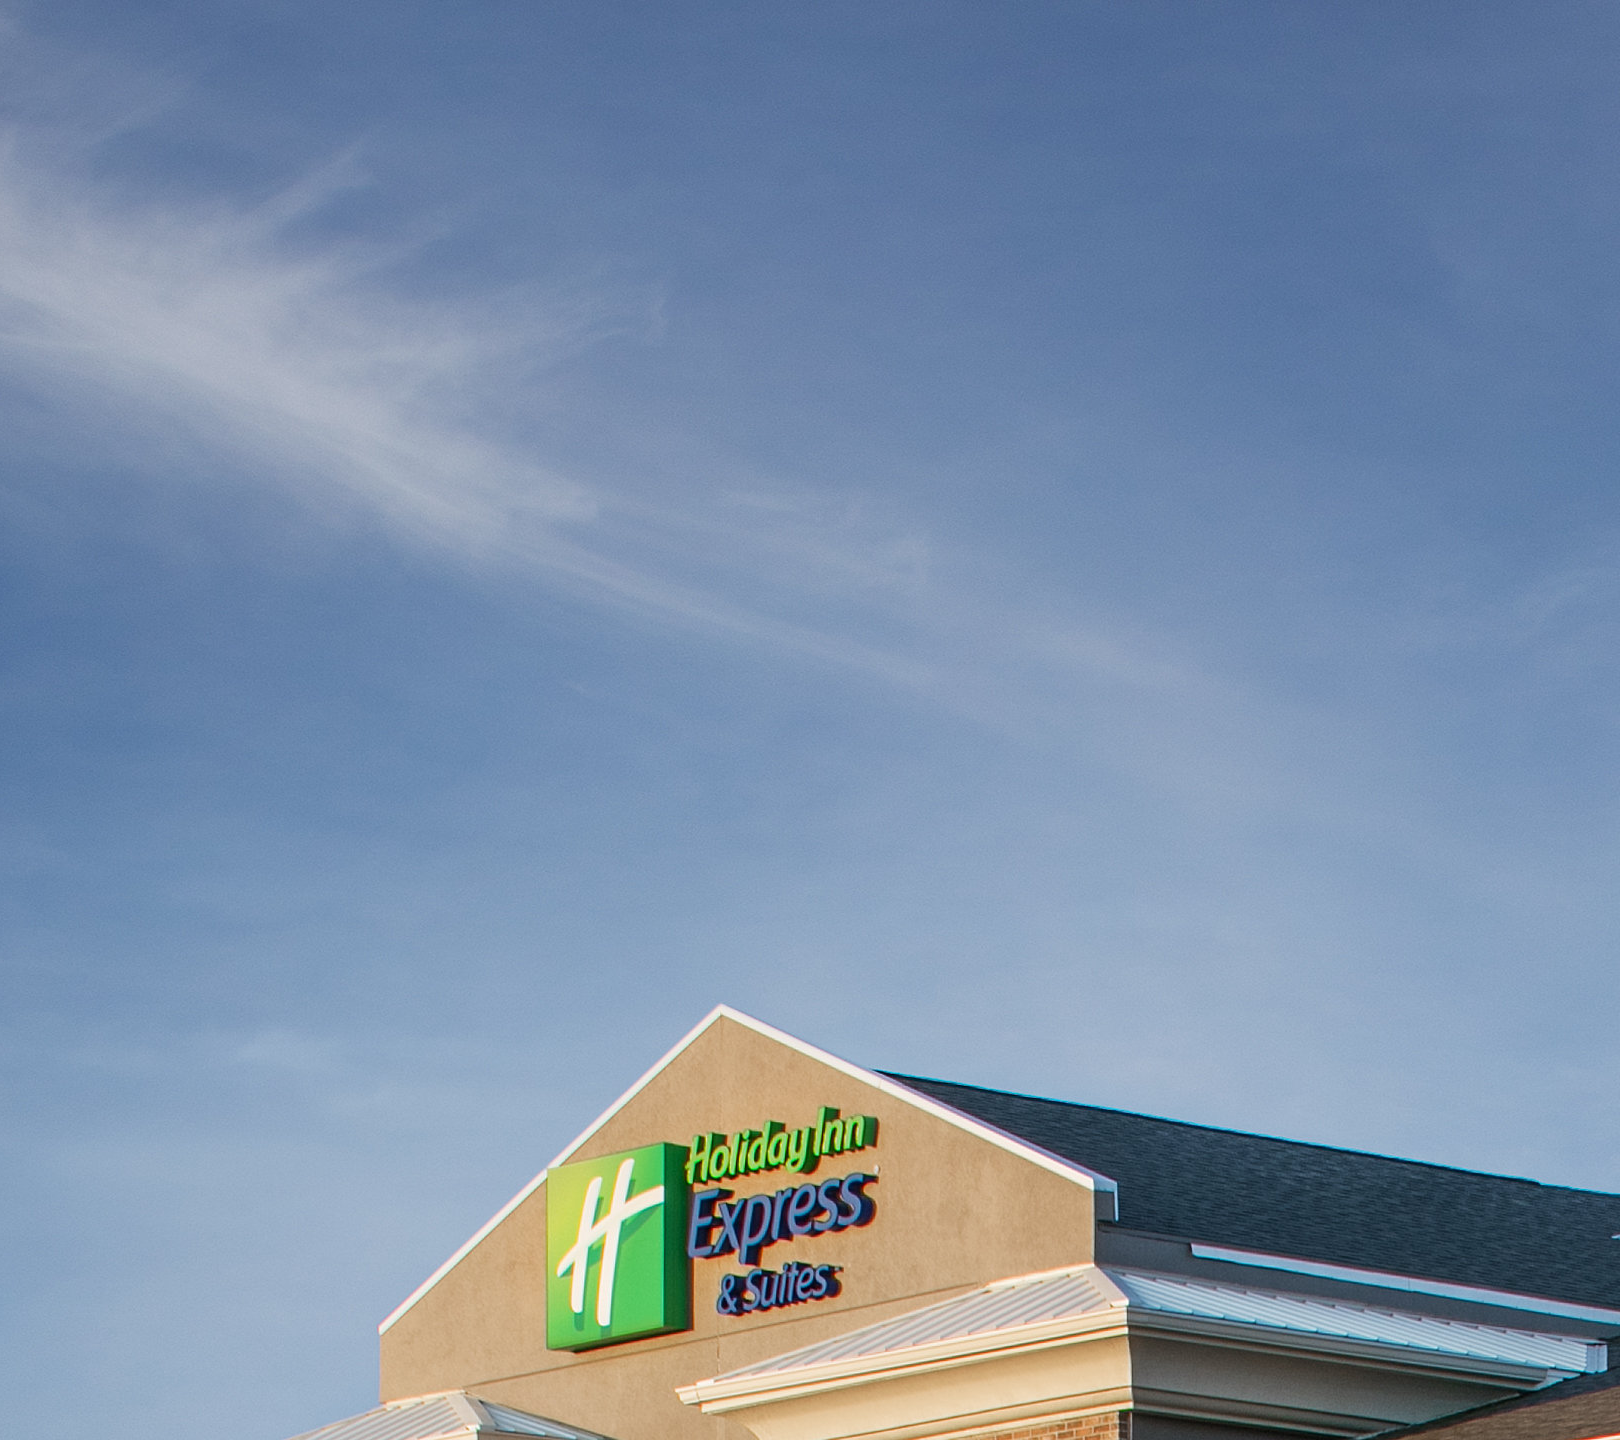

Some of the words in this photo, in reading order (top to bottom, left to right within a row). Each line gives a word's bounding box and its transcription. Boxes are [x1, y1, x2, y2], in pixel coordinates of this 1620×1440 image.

[685, 1119, 815, 1185] Holiday
[812, 1105, 871, 1158] Inn
[687, 1172, 870, 1266] Express
[716, 1273, 742, 1315] &
[742, 1261, 834, 1312] Suites
